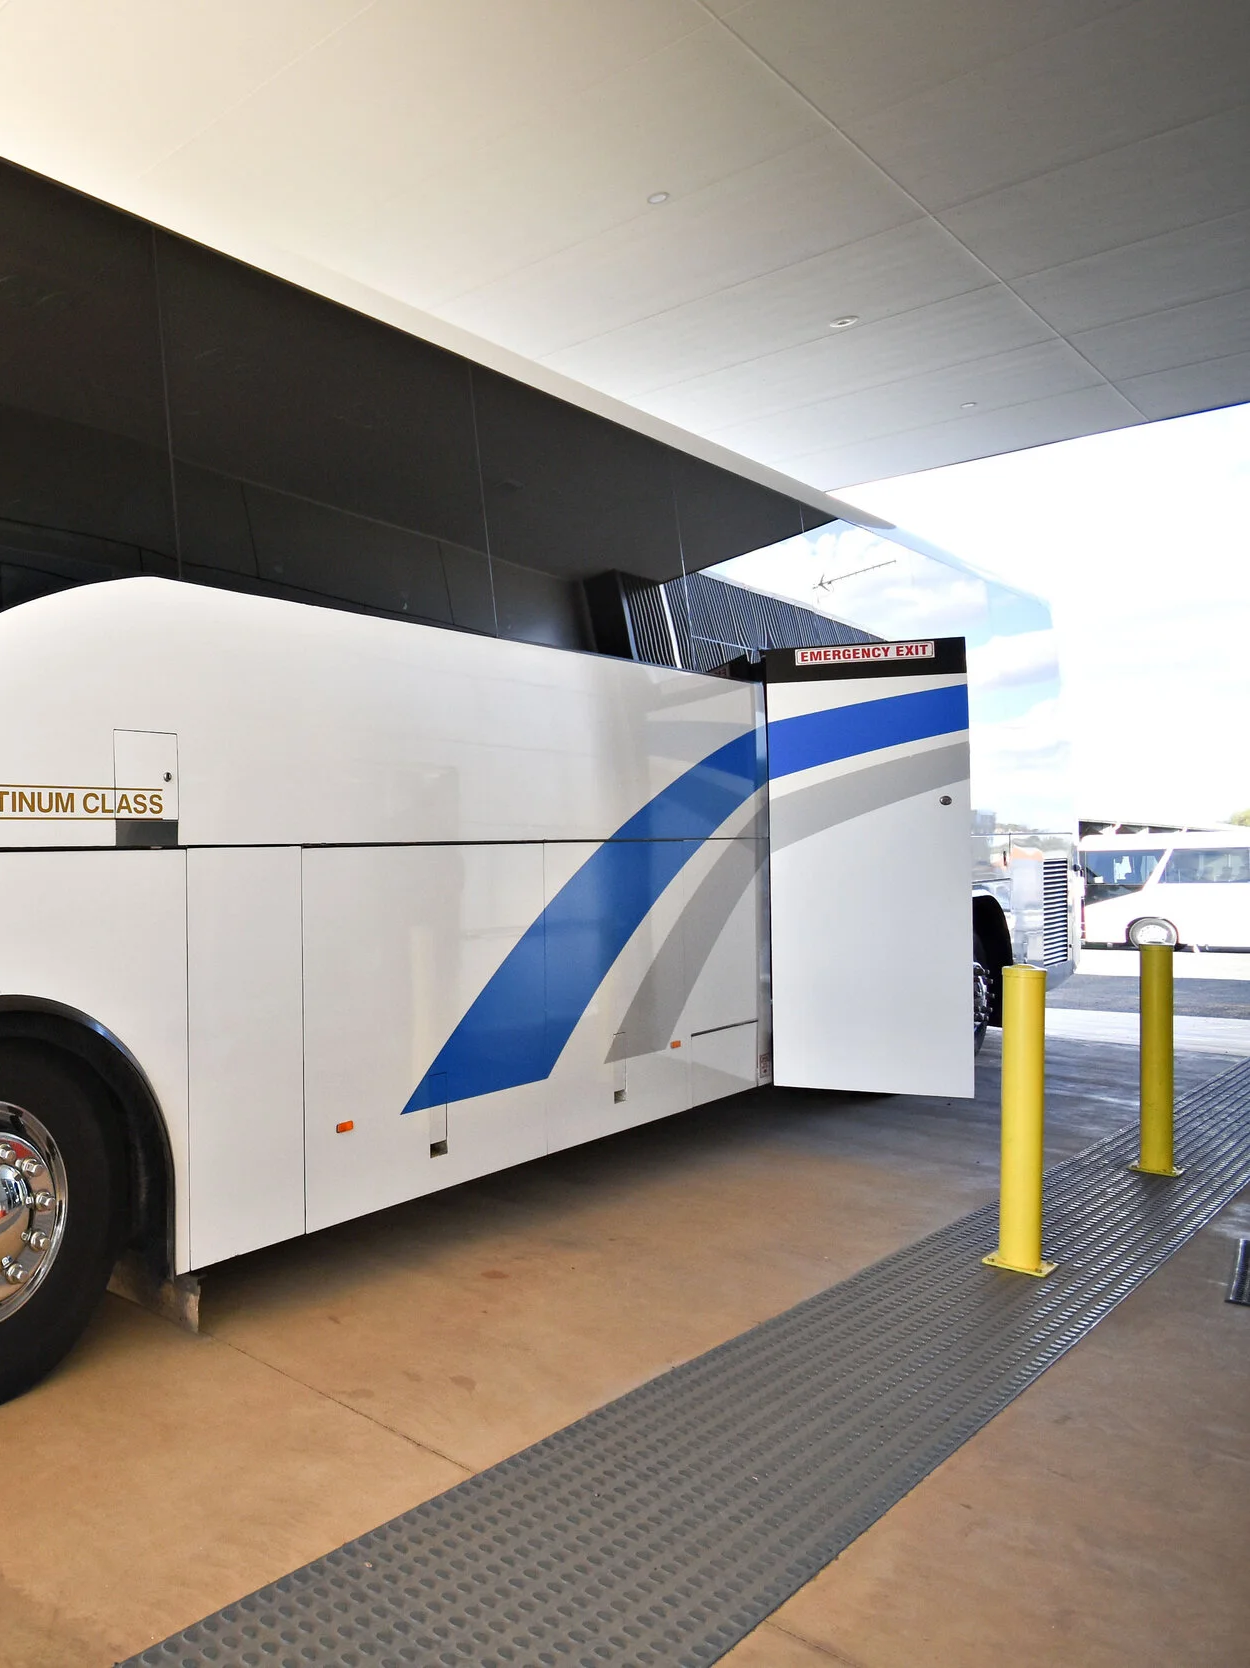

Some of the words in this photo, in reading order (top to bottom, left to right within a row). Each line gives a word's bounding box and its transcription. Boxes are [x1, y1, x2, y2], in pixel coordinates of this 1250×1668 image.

[801, 646, 890, 662] EMERGENCY
[896, 644, 928, 657] EXIT
[82, 792, 163, 815] CLASS
